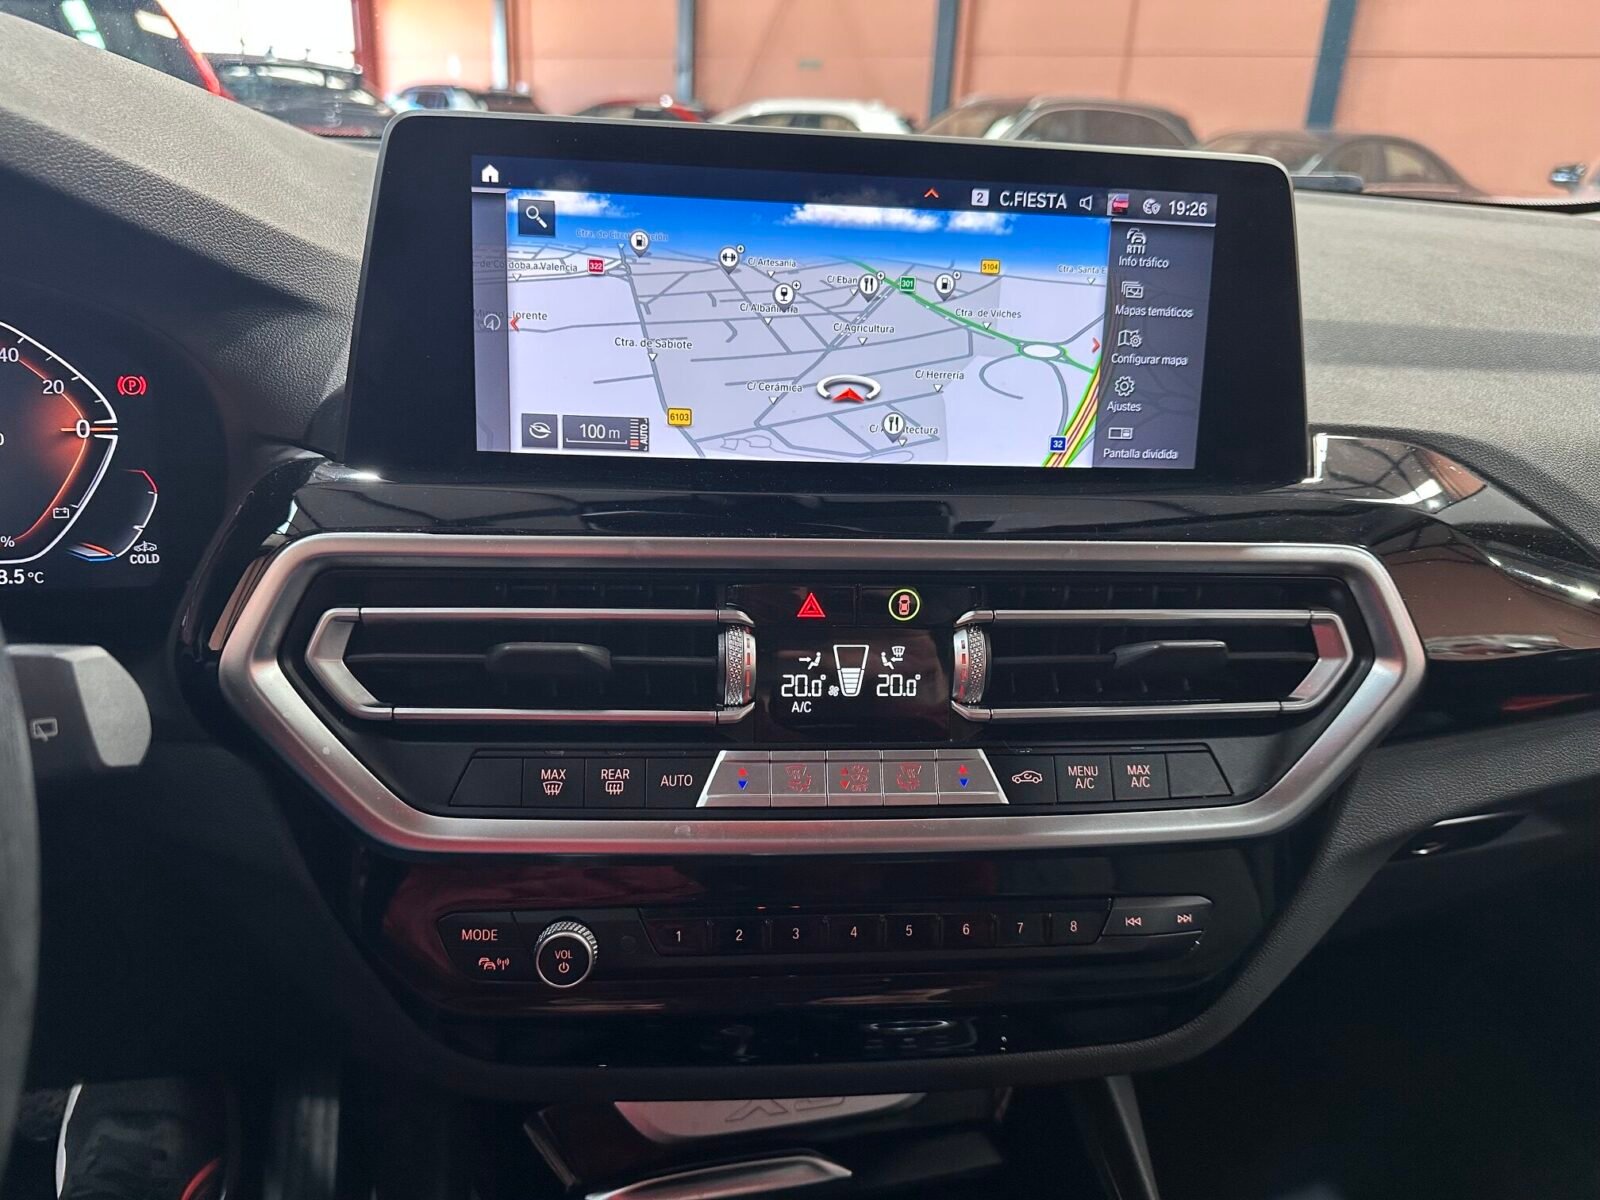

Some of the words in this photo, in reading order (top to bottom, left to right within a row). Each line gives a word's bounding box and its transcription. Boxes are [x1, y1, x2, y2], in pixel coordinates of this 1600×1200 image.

[999, 191, 1068, 210] C.FIESTA
[1168, 200, 1208, 217] 19:26
[1126, 244, 1146, 254] RTTI
[540, 262, 578, 272] Valencia
[588, 262, 604, 271] 322
[982, 261, 999, 272] 5104
[1119, 256, 1137, 266] Info
[1139, 257, 1169, 268] tráfico
[900, 278, 914, 288] 301
[977, 309, 989, 318] de
[990, 309, 1022, 319] Vilches
[1114, 305, 1147, 317] Mapas
[1148, 306, 1194, 318] temáticos
[844, 323, 896, 336] Agricultura
[614, 337, 638, 347] Ctra.
[640, 338, 653, 348] de
[655, 339, 693, 350] Sabiote
[0, 347, 19, 362] 40
[1111, 353, 1161, 366] Configurar
[1161, 357, 1188, 367] mapa
[926, 370, 965, 380] Herrería
[42, 380, 64, 395] 20
[758, 382, 803, 392] Cerámica
[1107, 401, 1142, 412] Ajustes
[670, 413, 690, 422] 6103
[76, 420, 91, 438] 0
[580, 423, 606, 439] 100
[608, 428, 621, 439] m
[640, 423, 648, 445] AUTO
[1052, 440, 1063, 448] 32
[1103, 448, 1141, 459] Pantalla
[1142, 449, 1178, 460] dividida
[0, 535, 15, 548] %
[130, 554, 160, 564] COLD
[791, 701, 812, 713] A/C
[540, 768, 567, 780] MAX
[600, 768, 630, 780] REAR
[1067, 765, 1099, 777] MENU
[1126, 764, 1151, 776] MAX
[660, 774, 693, 787] AUTO
[1075, 777, 1095, 789] A/C
[1130, 776, 1151, 788] A/C
[850, 925, 858, 939] 4
[905, 923, 913, 937] 5
[962, 922, 970, 936] 6
[1017, 921, 1024, 935] 7
[1069, 919, 1078, 933] 8
[461, 928, 498, 942] MODE
[675, 930, 682, 943] 1
[735, 929, 743, 942] 2
[792, 927, 800, 940] 3
[554, 950, 573, 960] VOL
